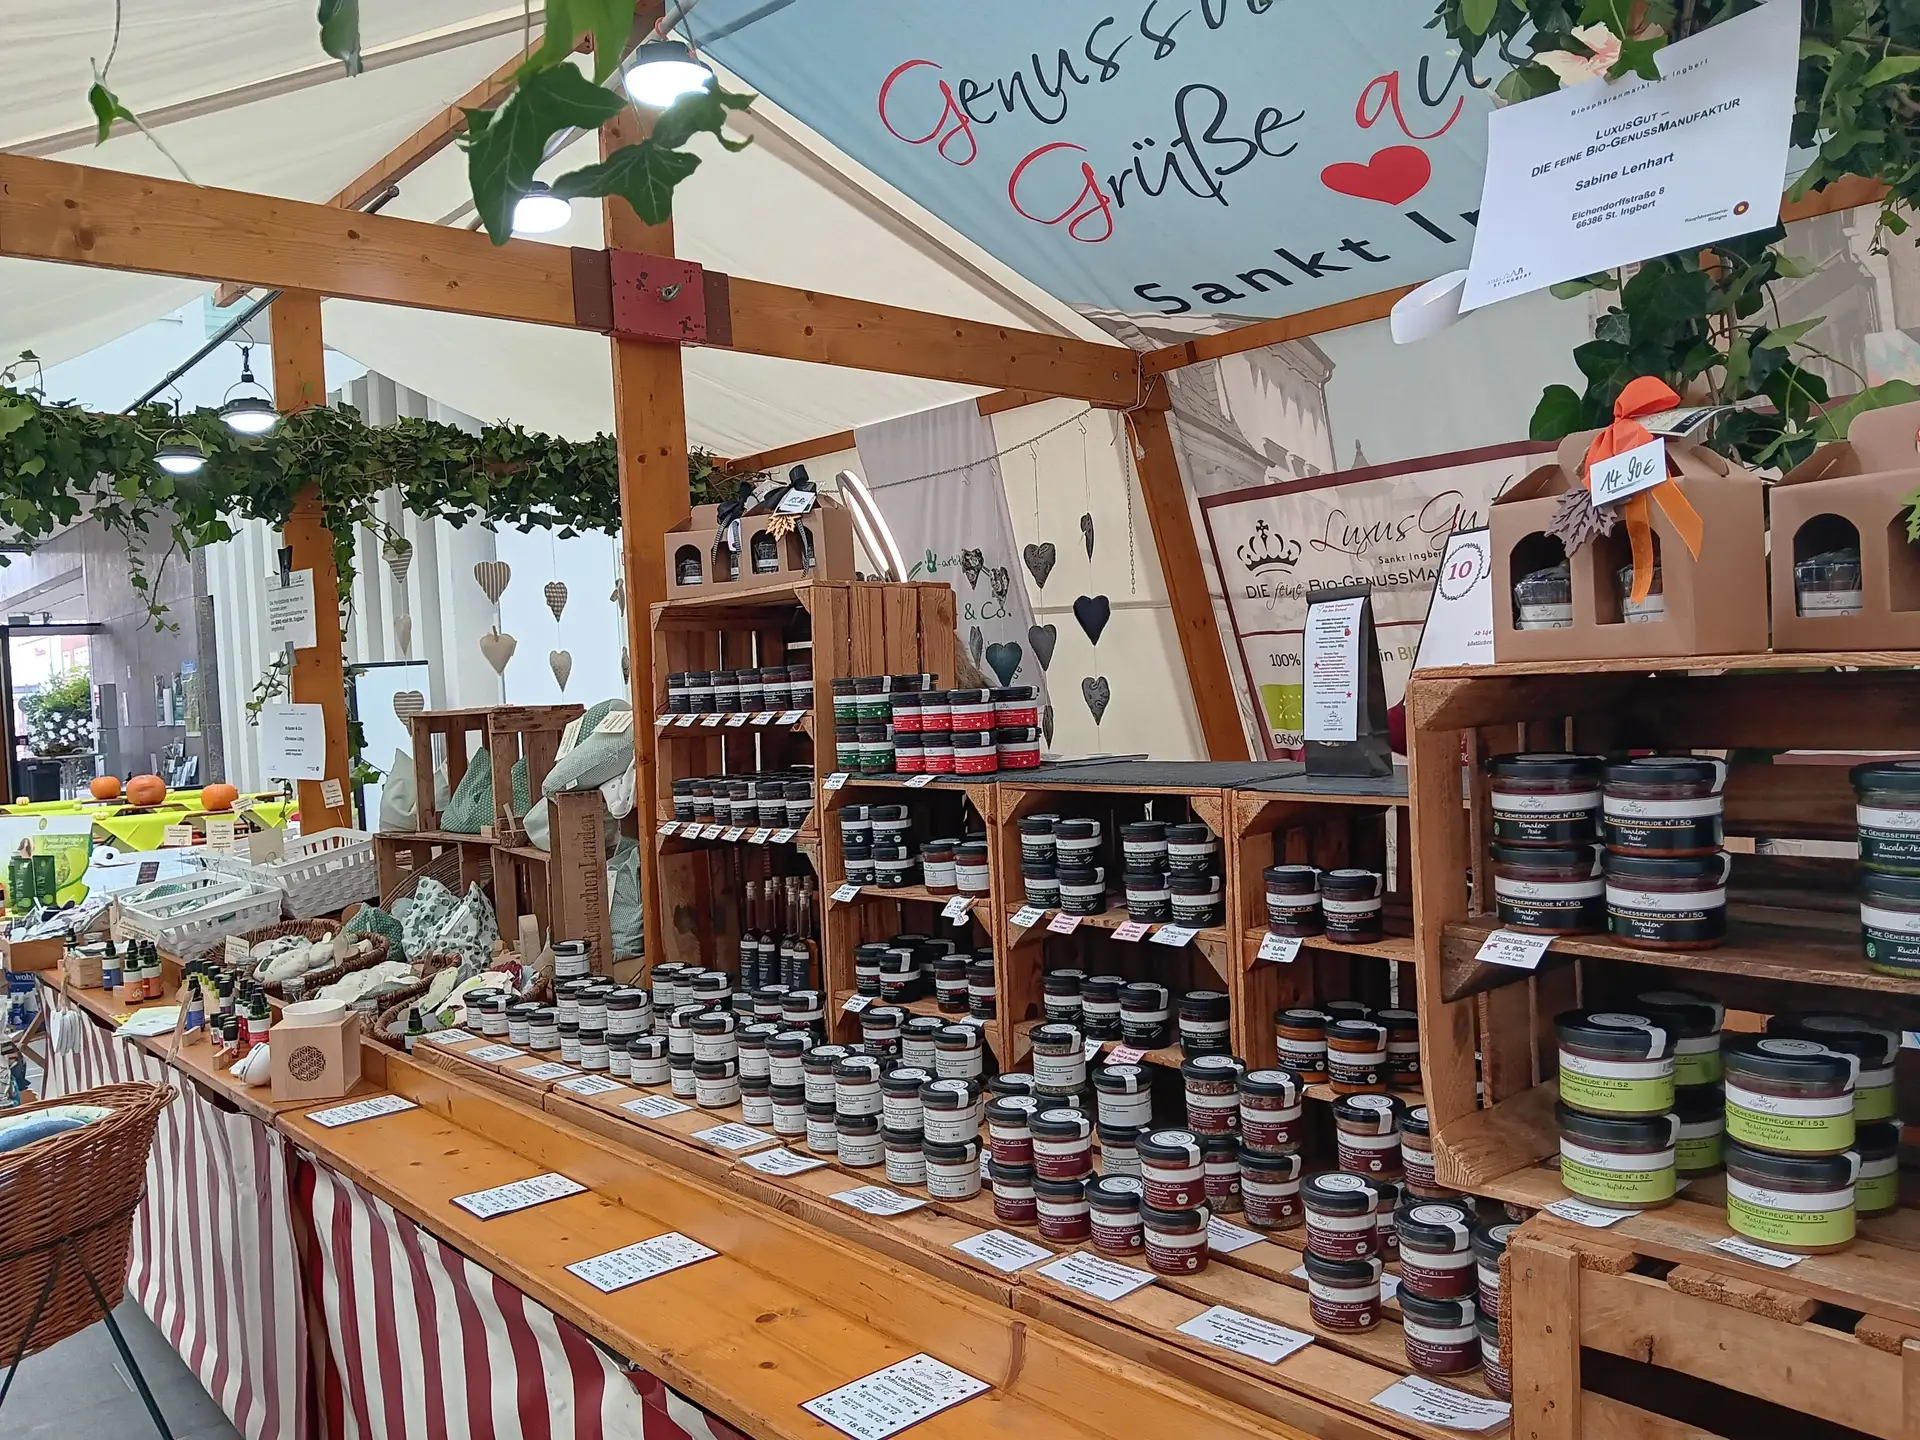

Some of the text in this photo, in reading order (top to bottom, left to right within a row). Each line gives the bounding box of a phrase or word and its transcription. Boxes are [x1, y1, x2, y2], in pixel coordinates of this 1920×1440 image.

[1007, 83, 1305, 243] Grüße
[1531, 161, 1551, 178] DIE
[1574, 151, 1675, 192] Sabine Lenhart
[1571, 186, 1666, 221] Eichendorffstraße 8
[1575, 199, 1657, 230] 66386 St. Ingbert
[1134, 236, 1391, 314] Sankt
[1378, 553, 1406, 565] Sankt
[1447, 560, 1473, 581] 10
[963, 601, 1012, 620] & Co.
[1245, 583, 1271, 599] DIE
[1265, 581, 1304, 611] feine
[1269, 652, 1302, 668] 100%
